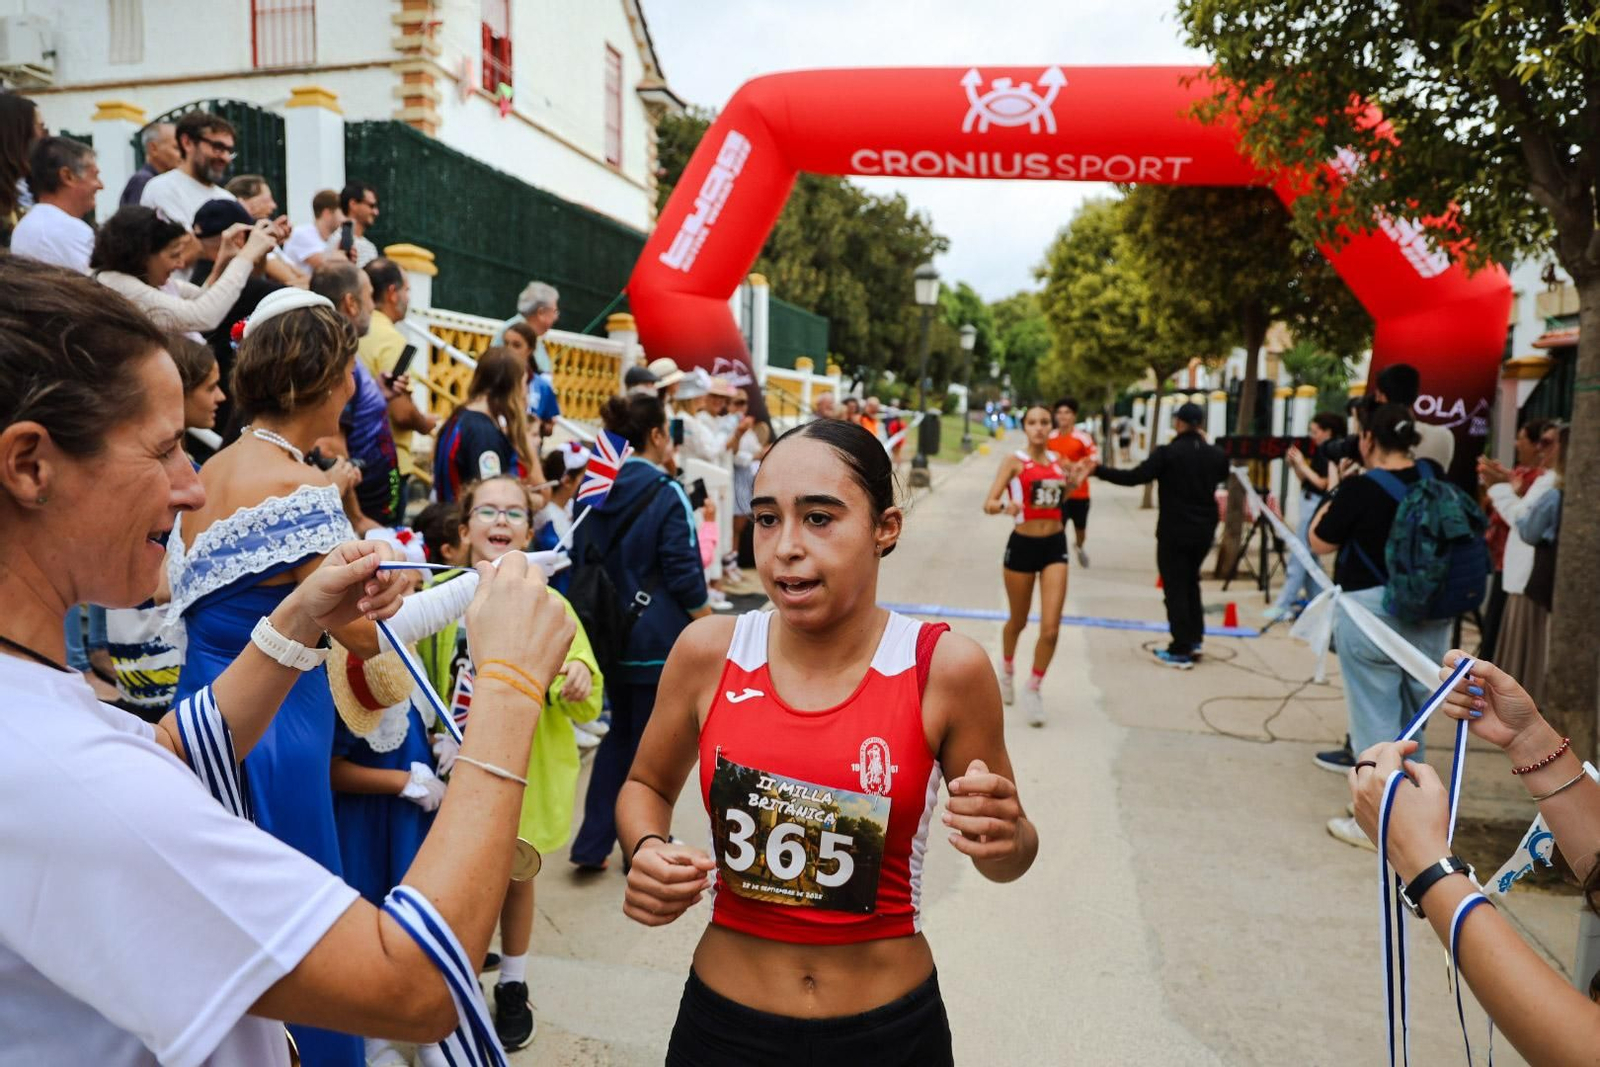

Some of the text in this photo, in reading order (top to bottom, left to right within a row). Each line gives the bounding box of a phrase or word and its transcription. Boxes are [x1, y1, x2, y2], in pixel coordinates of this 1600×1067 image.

[756, 776, 833, 805] II MILLA
[748, 793, 836, 825] BRITÁNICA
[725, 809, 854, 887] 365
[761, 885, 796, 896] SEPTIEMBRE
